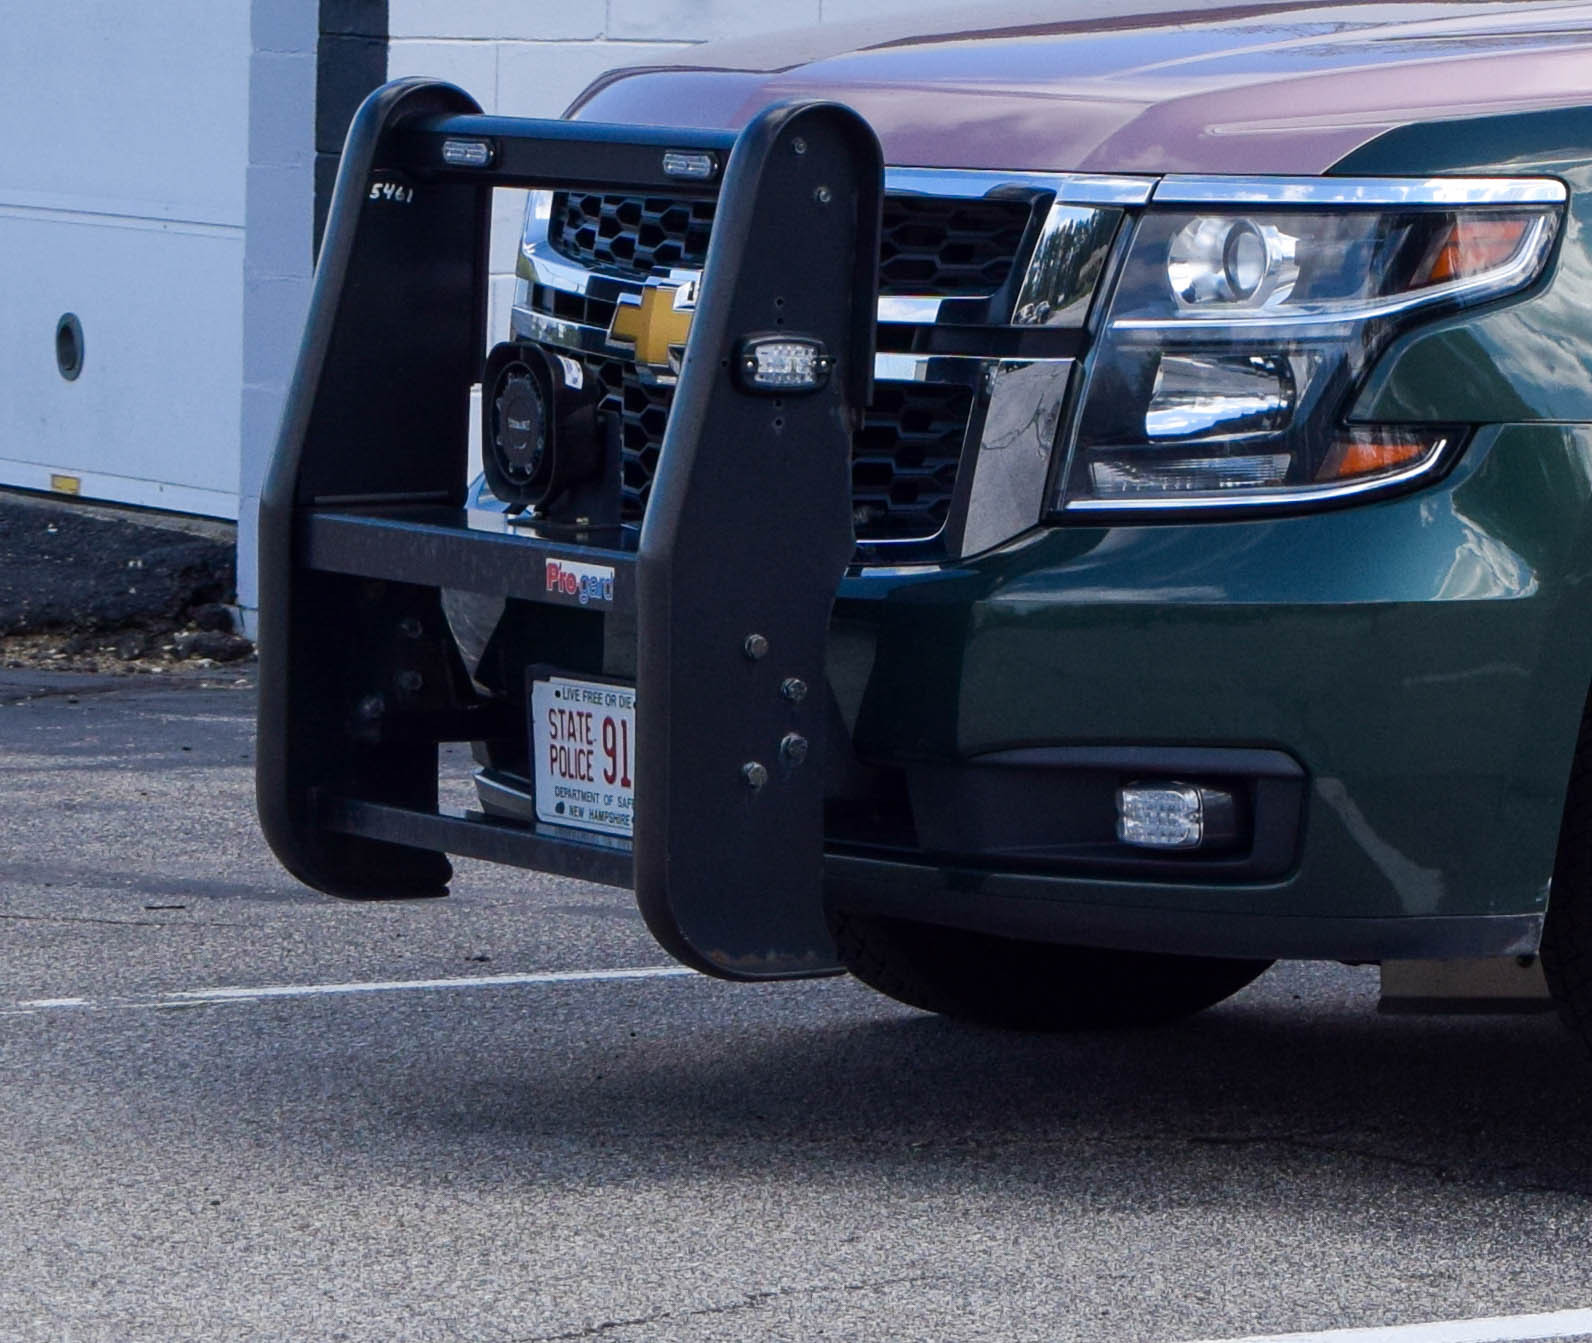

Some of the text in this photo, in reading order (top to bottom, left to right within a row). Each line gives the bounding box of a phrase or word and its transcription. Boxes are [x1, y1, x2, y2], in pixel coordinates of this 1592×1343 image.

[369, 182, 414, 203] 5461
[562, 687, 633, 709] LIVE FREE OR DIE
[548, 708, 593, 745] STATE
[602, 715, 631, 788] 91
[549, 744, 594, 783] POLICE
[554, 785, 600, 804] DEPARTMENT
[603, 794, 614, 806] OF
[569, 805, 630, 826] NEW HAMPSHIRE
